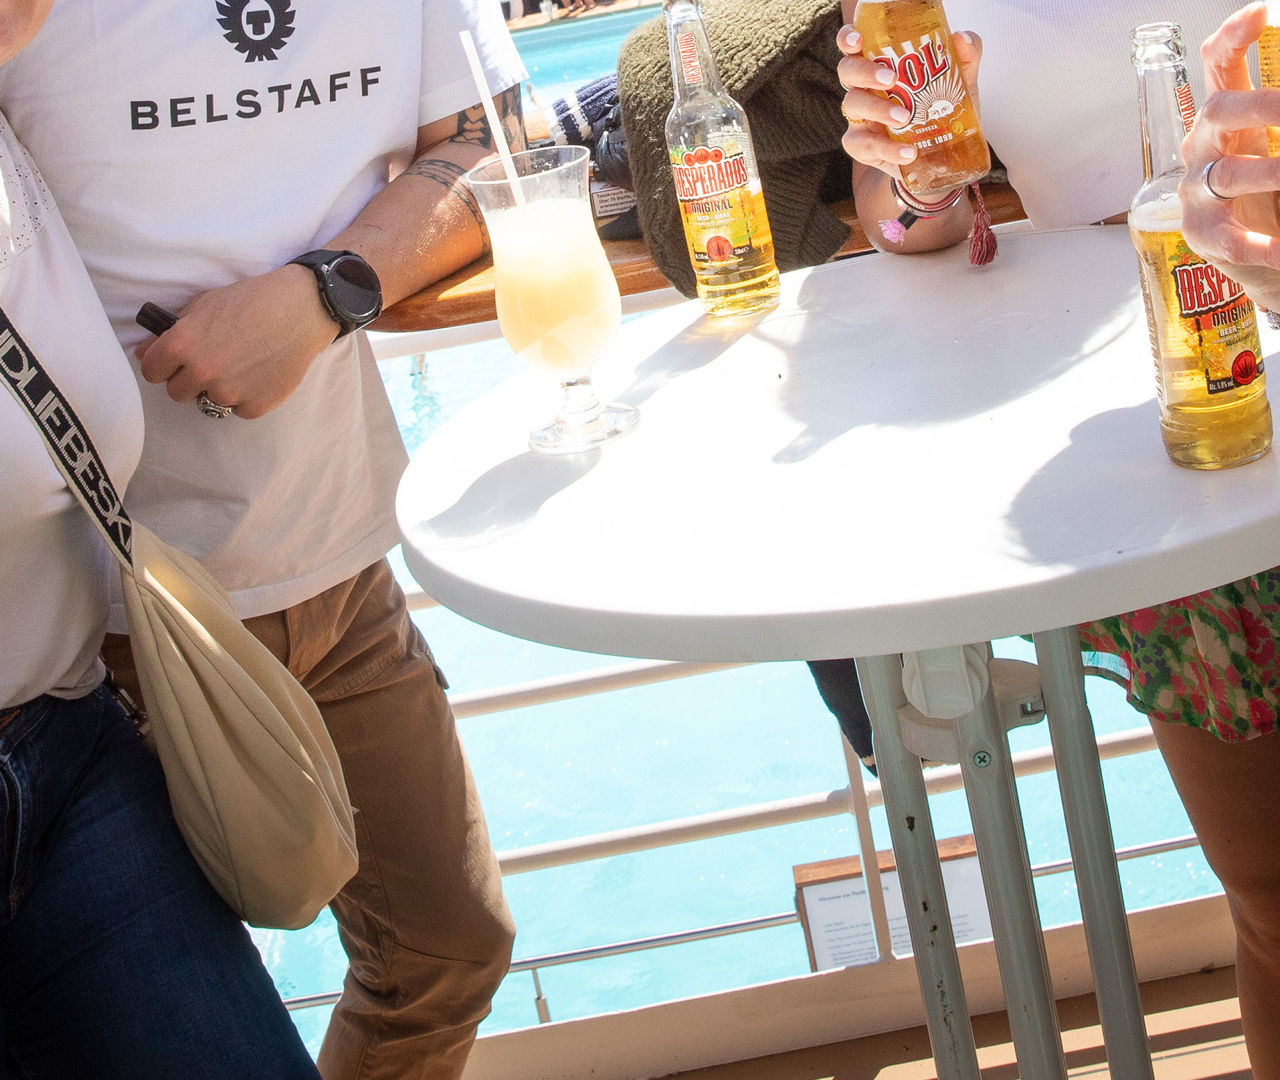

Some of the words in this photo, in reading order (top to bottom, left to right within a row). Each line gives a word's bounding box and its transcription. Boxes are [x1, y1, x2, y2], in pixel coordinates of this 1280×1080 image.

[129, 65, 382, 131] BELSTAFF
[691, 198, 734, 214] ORIGINAL
[19, 366, 132, 554] LIEBESK
